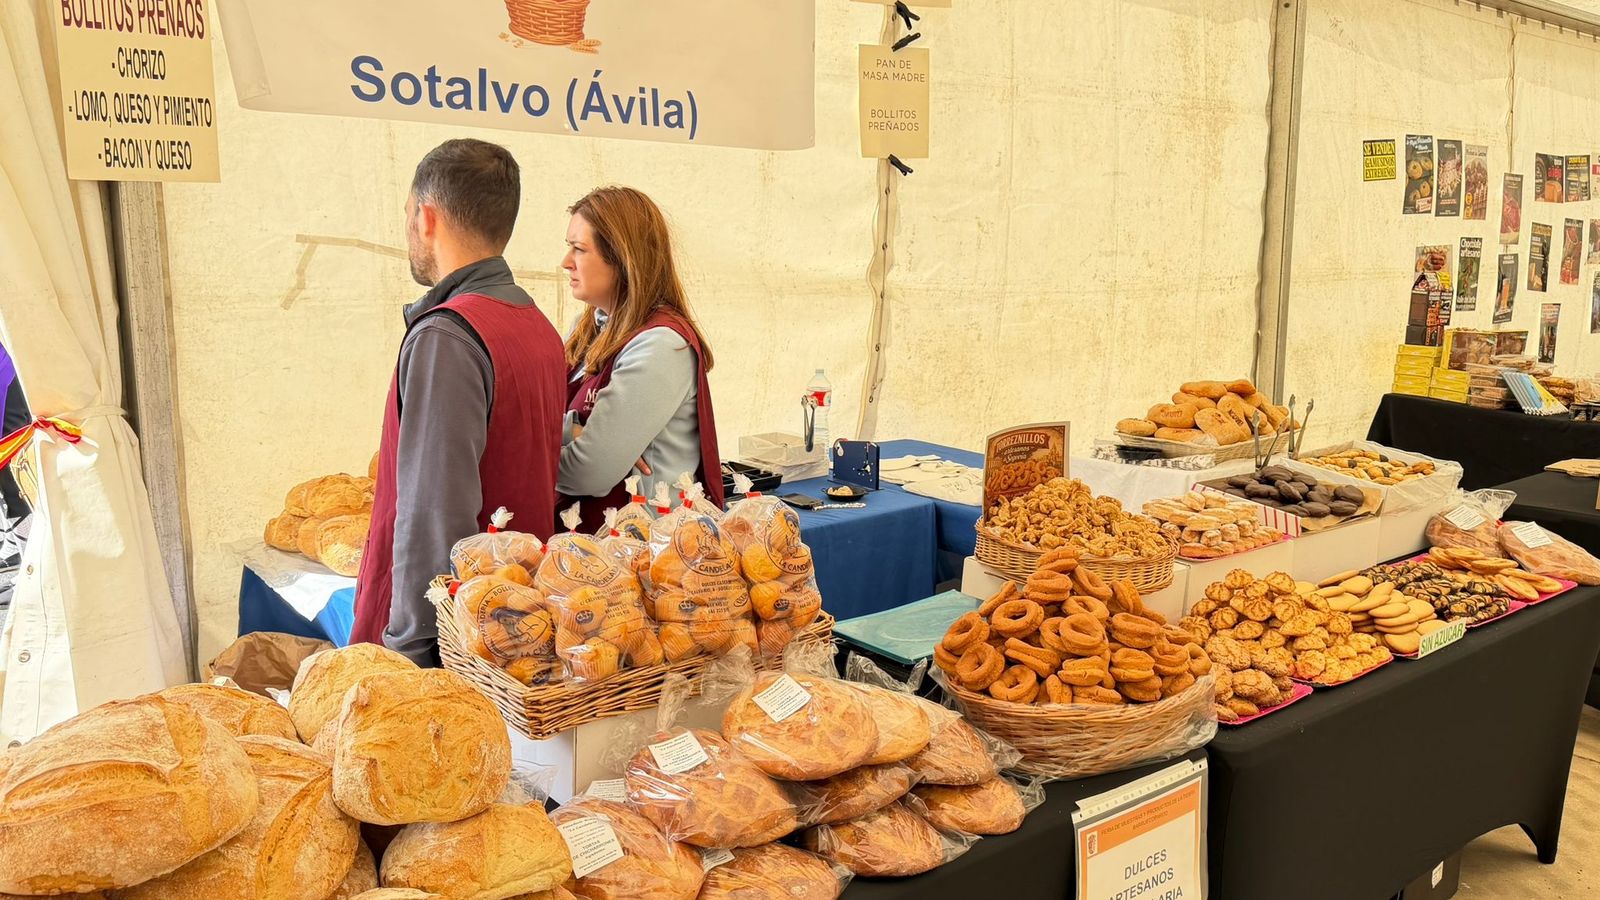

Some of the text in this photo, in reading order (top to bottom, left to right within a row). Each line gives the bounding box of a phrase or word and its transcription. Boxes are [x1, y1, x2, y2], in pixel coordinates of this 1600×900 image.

[876, 59, 911, 69] PAN DE
[863, 71, 925, 83] MASA MADRE
[350, 55, 698, 140] Sotalvo (Ávila)
[114, 92, 151, 125] QUESO
[153, 95, 161, 125] Y
[164, 95, 212, 128] PIMIENTO
[871, 109, 917, 119] BOLLITOS
[868, 121, 919, 132] PREÑADOS
[144, 140, 152, 169] Y
[155, 139, 192, 172] QUESO
[1372, 141, 1394, 155] VENDEN
[1421, 623, 1463, 656] SIN AZUCAR
[1124, 849, 1167, 880] DULCES
